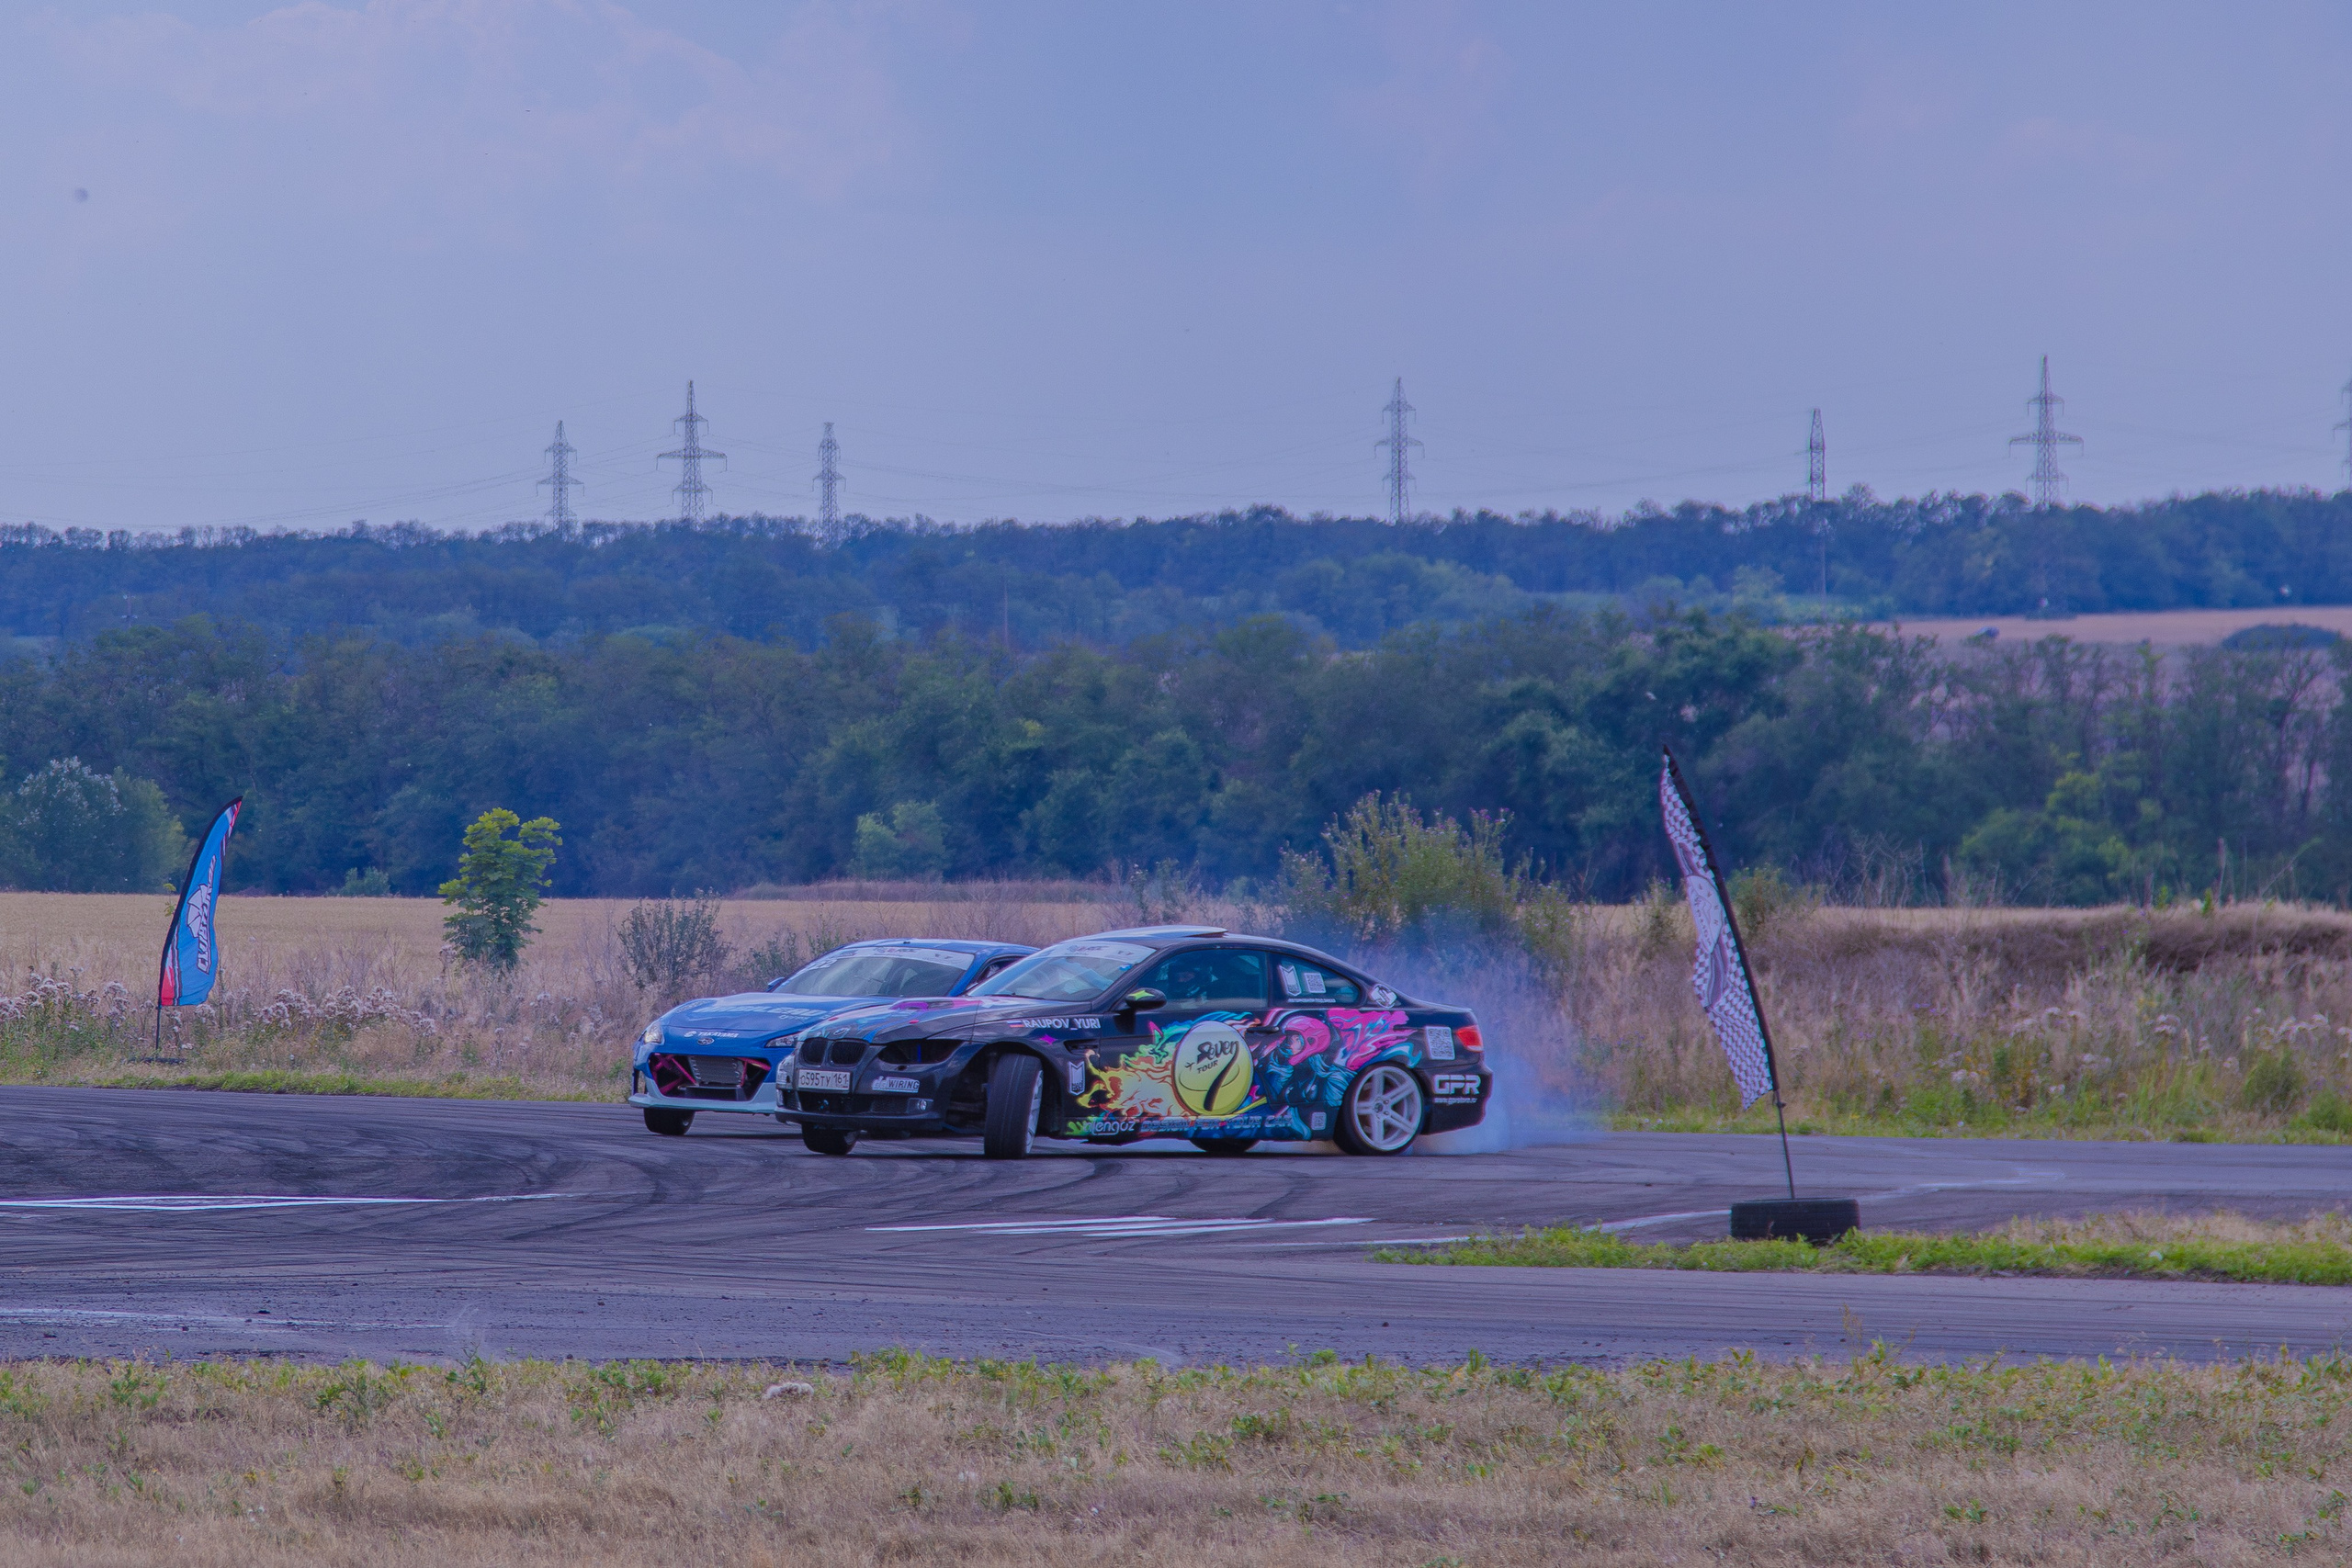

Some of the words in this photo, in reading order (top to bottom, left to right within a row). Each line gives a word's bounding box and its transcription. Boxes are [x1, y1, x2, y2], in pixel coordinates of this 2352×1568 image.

[1022, 1018, 1102, 1031] RAUPOV_YURI
[1197, 1060, 1219, 1074] TOUR
[833, 1073, 847, 1084] 161
[888, 1079, 920, 1089] WIRING
[1433, 1074, 1481, 1094] GPR
[1140, 1118, 1190, 1133] DESIGN
[1194, 1117, 1220, 1131] FOR
[1225, 1115, 1262, 1129] YOUR
[1264, 1115, 1293, 1127] CAR
